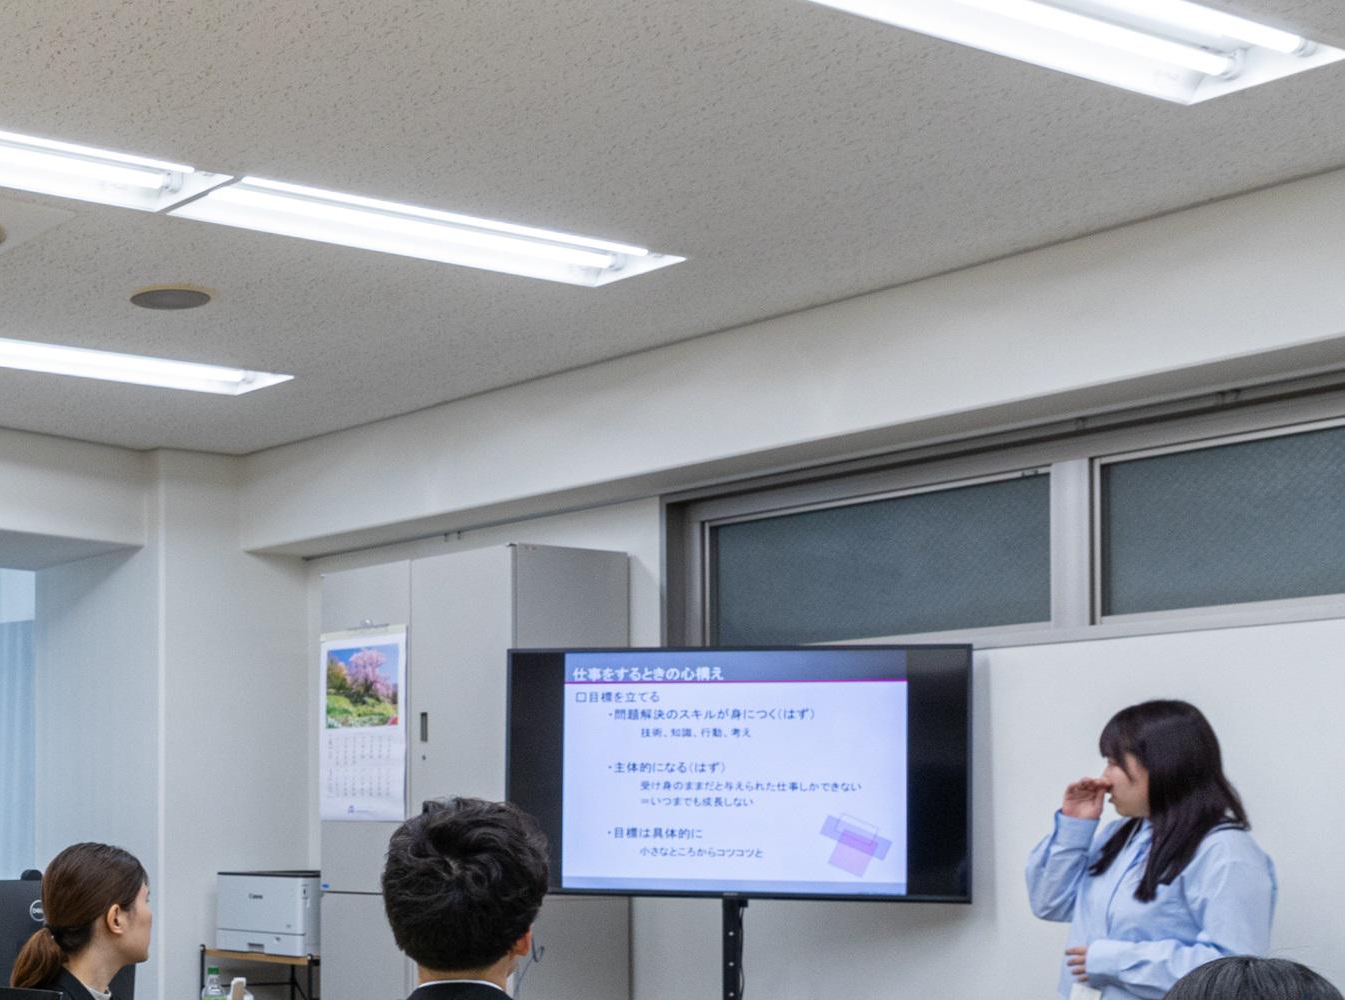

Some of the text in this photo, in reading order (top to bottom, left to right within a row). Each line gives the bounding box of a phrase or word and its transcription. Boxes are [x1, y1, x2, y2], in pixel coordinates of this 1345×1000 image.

[572, 666, 724, 682] 仕事をするときの心構え
